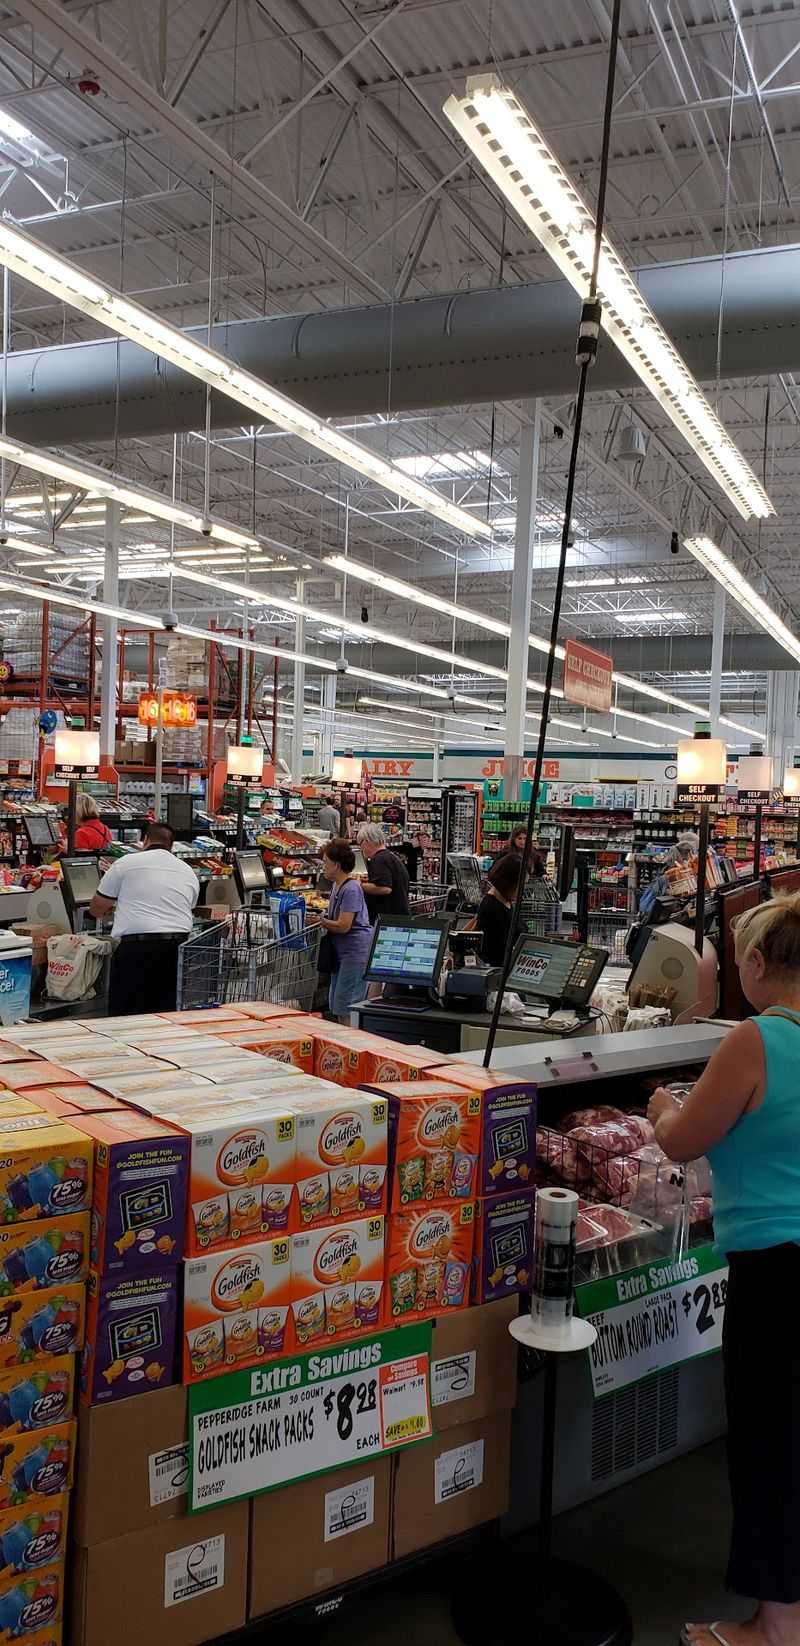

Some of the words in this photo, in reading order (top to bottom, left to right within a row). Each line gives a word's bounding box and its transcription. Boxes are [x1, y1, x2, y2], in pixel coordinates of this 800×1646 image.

[362, 759, 414, 776] AIRY
[482, 760, 560, 779] JICE
[678, 794, 716, 802] CHECKOUT
[688, 785, 706, 793] SELF
[48, 961, 74, 973] WinCo
[517, 955, 548, 970] WinCo
[515, 967, 540, 977] FOODS
[409, 1068, 418, 1080] 30
[373, 1105, 385, 1116] 30
[469, 1098, 480, 1109] 30
[279, 1121, 292, 1133] 30
[424, 1111, 459, 1135] Goldfish
[324, 1122, 361, 1150] Goldfish
[128, 1152, 144, 1160] JOIN
[145, 1150, 158, 1159] THE
[160, 1148, 173, 1156] FUN
[223, 1139, 265, 1170] Goldfish
[52, 1180, 82, 1199] 75%
[461, 1206, 473, 1217] 30
[368, 1220, 381, 1232] 30
[415, 1222, 450, 1247] Goldfish
[274, 1243, 287, 1255] 30
[319, 1240, 358, 1269] Goldfish
[49, 1252, 79, 1272] 75%
[117, 1280, 133, 1289] JOIN
[135, 1279, 148, 1287] THE
[218, 1263, 261, 1296] Goldfish
[615, 1273, 648, 1300] Extra
[649, 1257, 699, 1288] Savings
[45, 1323, 72, 1340] 75%
[625, 1312, 652, 1356] ROUND
[653, 1300, 679, 1344] ROAST
[250, 1363, 302, 1396] Extra
[308, 1342, 382, 1381] Savings
[33, 1392, 64, 1413] 75%
[198, 1403, 253, 1432] PEPPERIDGE
[256, 1396, 281, 1414] FARM
[289, 1394, 299, 1405] 30
[300, 1386, 324, 1403] COUNT
[198, 1432, 246, 1474] GOLDFISH
[249, 1417, 282, 1458] SNACK
[284, 1406, 315, 1447] PACKS
[356, 1432, 380, 1450] EACH
[37, 1463, 64, 1481] 75%
[26, 1534, 57, 1555] 75%
[23, 1597, 53, 1619] 75%
